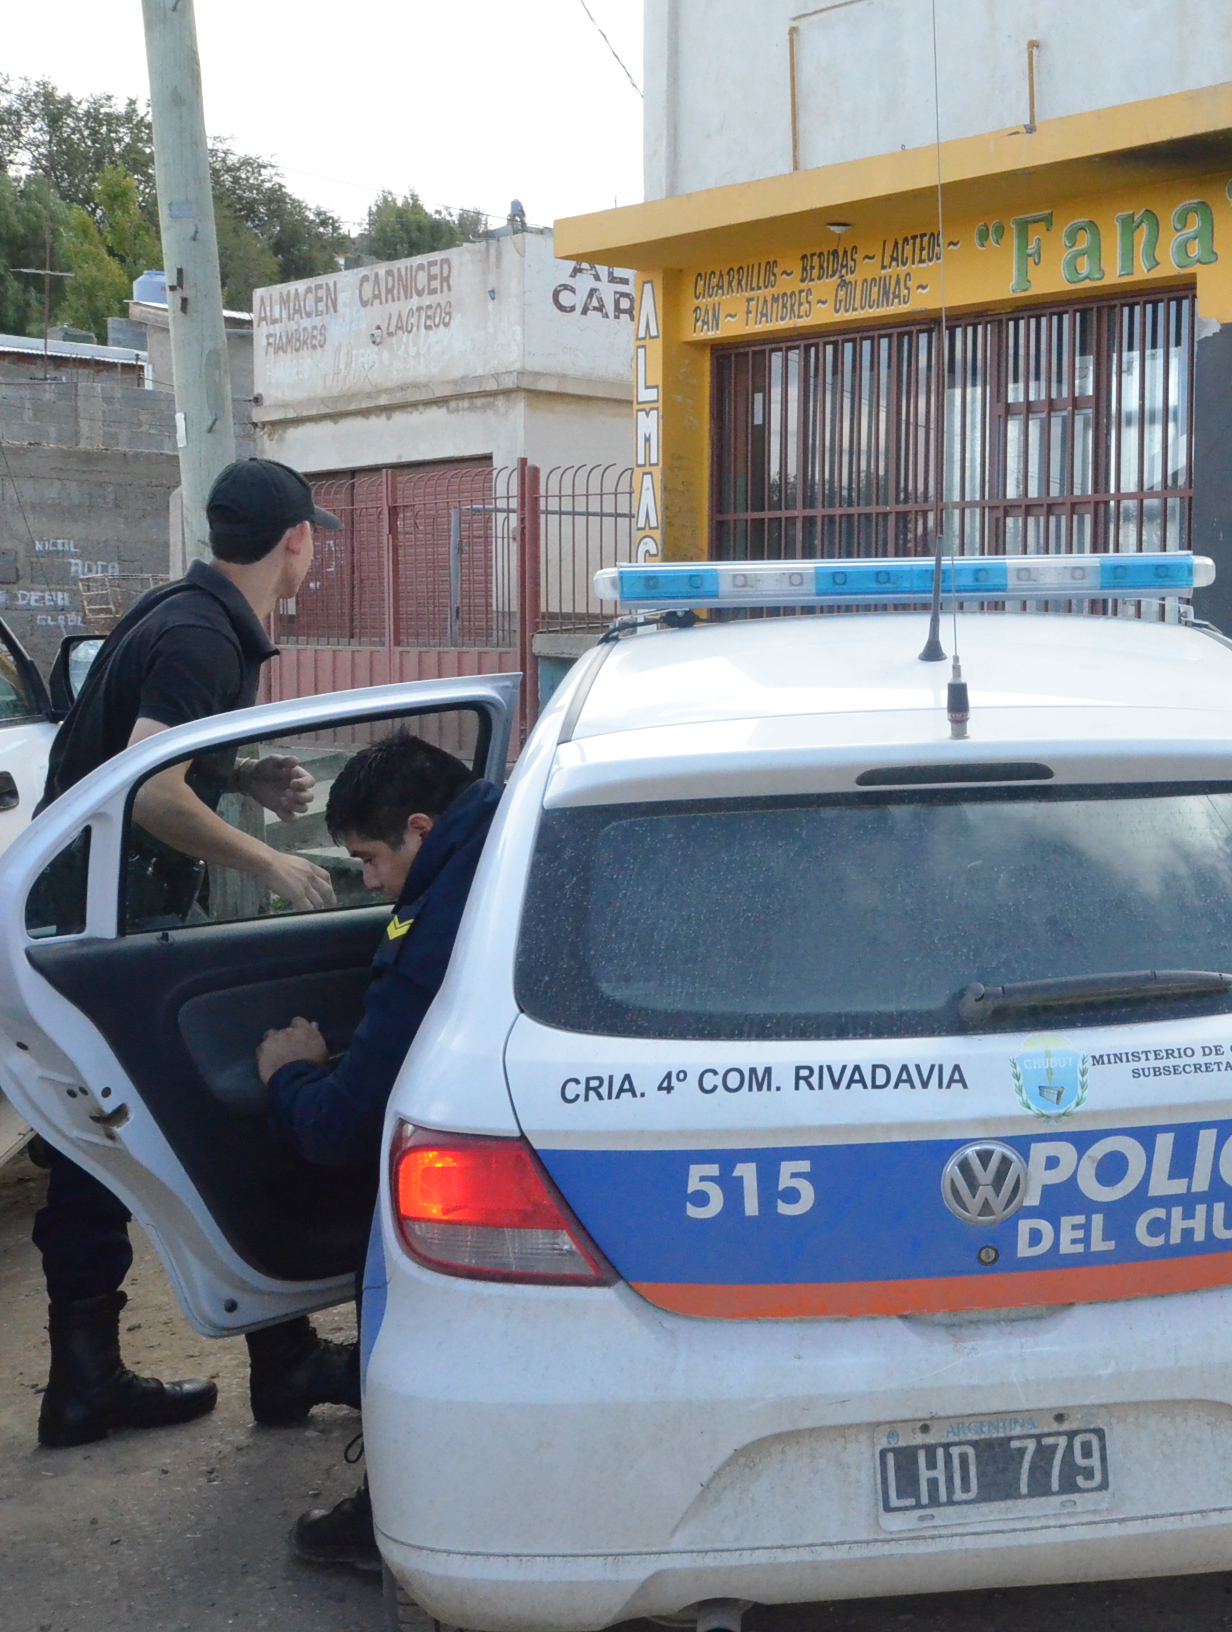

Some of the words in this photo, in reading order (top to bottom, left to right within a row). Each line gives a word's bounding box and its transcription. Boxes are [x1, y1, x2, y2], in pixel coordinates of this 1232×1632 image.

[358, 257, 452, 308] CARNICER
[693, 260, 778, 303] CIGARRILLOS
[799, 245, 858, 285] BEBIDAS
[880, 231, 944, 273] LACTEOS
[257, 280, 338, 328] ALMACEN
[386, 300, 453, 337] LACTEOS
[552, 283, 635, 322] CAR
[693, 301, 722, 336] PAN
[744, 287, 813, 329] FIAMBRES
[832, 272, 912, 316] GOLOCINAS
[265, 324, 327, 356] FIAMBRES
[1090, 1047, 1195, 1066] MINISTERIO
[1200, 1044, 1225, 1057] DE
[560, 1074, 646, 1104] CRIA.
[699, 1067, 781, 1094] COM.
[794, 1064, 969, 1091] RIVADAVIA
[685, 1159, 816, 1219] 515
[1017, 1213, 1116, 1258] DEL
[945, 1415, 1039, 1438] ARGENTINA
[886, 1443, 978, 1508] LHD
[1009, 1432, 1103, 1496] 779
